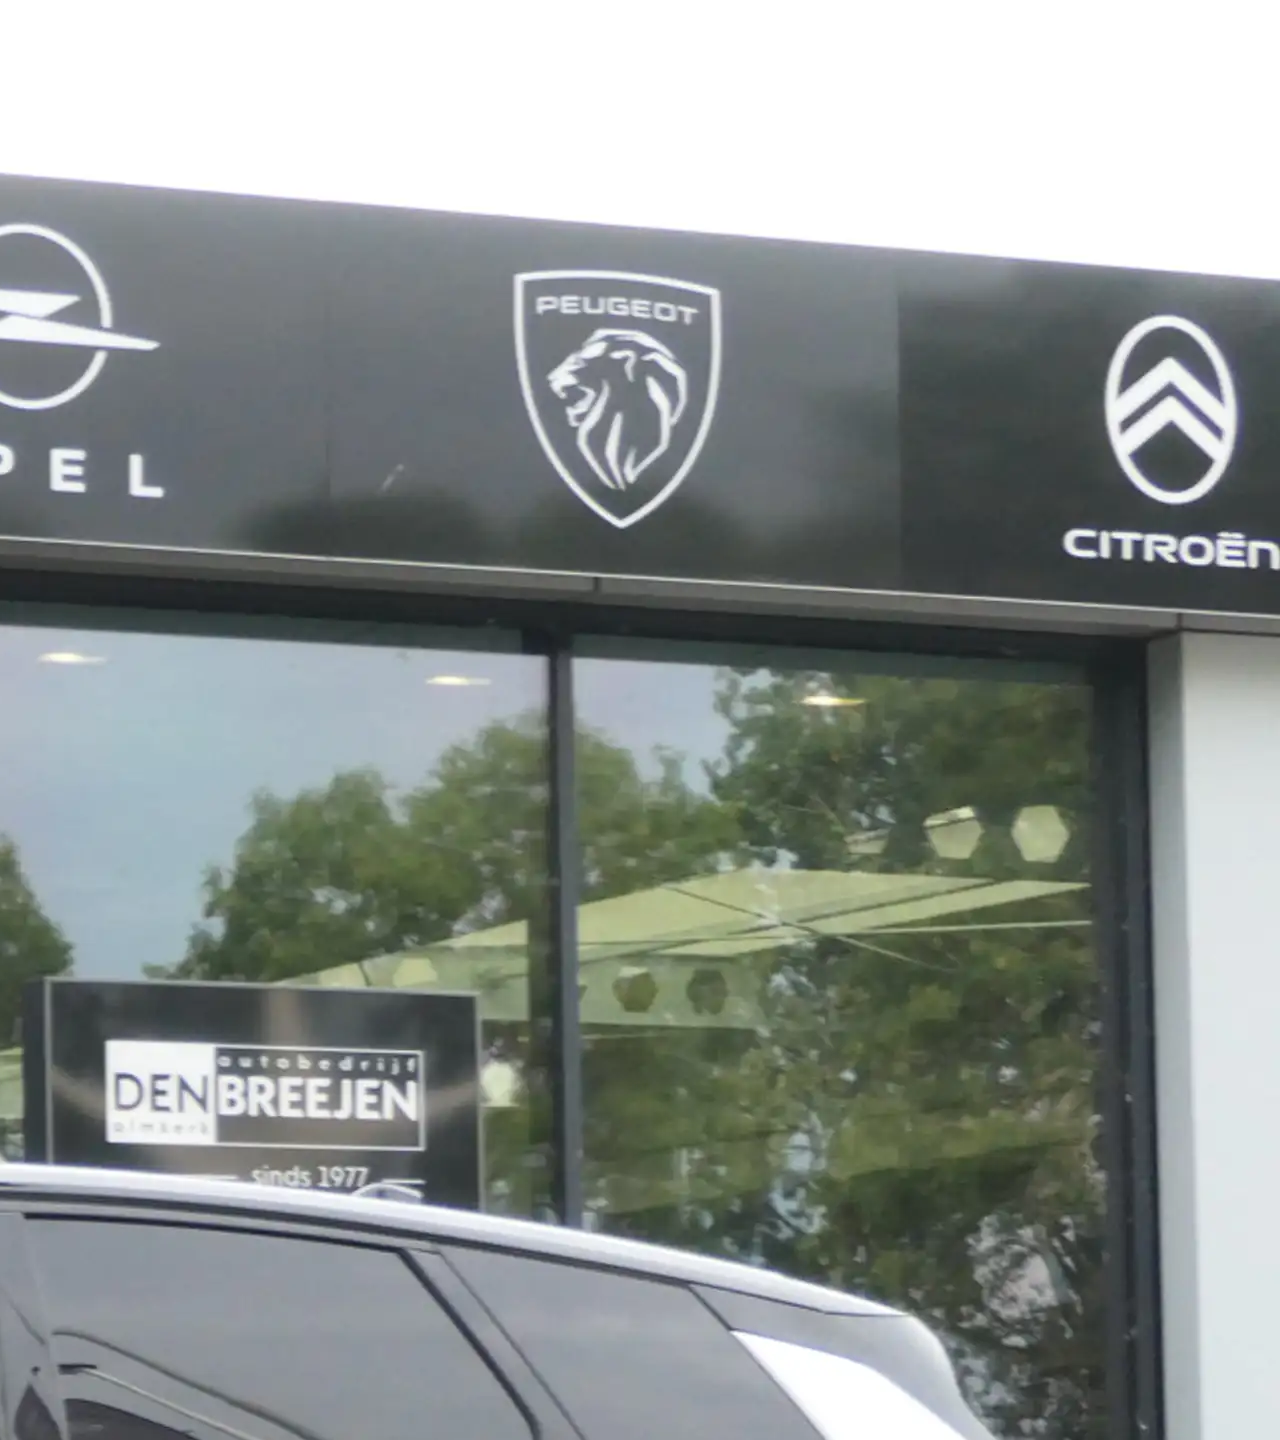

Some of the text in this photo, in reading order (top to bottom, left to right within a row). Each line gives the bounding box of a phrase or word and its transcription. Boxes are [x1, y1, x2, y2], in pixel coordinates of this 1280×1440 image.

[535, 294, 699, 326] PEUGEOT
[216, 1054, 416, 1076] autobedrijf
[113, 1071, 419, 1122] DEN BREEJEN
[251, 1164, 369, 1189] sinds 1977
